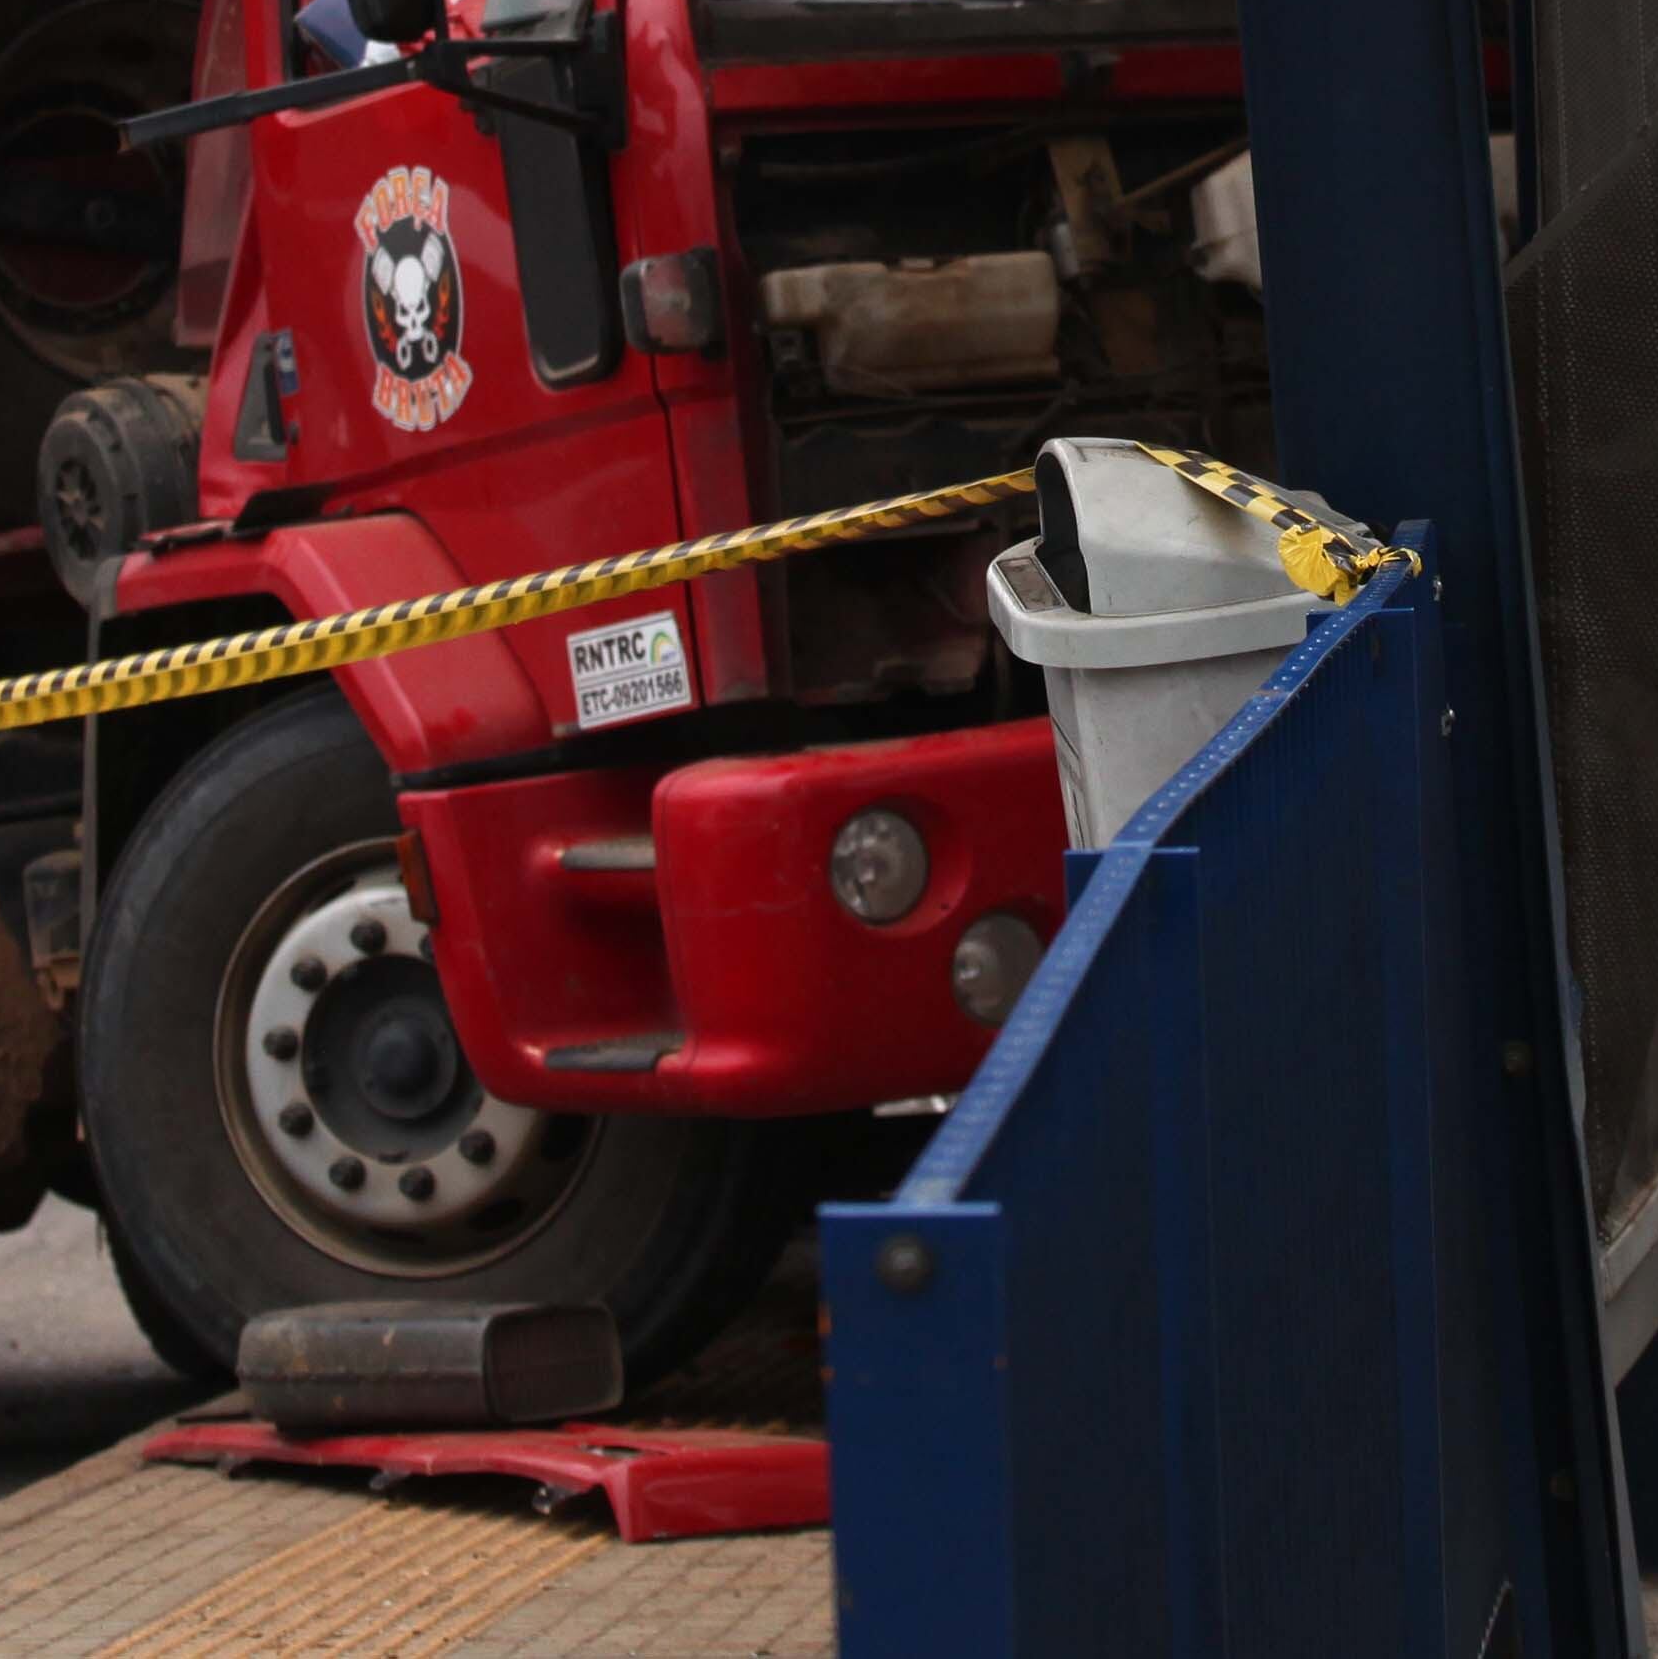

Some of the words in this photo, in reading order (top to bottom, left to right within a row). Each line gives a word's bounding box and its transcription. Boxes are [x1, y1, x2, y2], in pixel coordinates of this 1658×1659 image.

[353, 164, 450, 255] FORÇA
[372, 350, 474, 432] BRUTA
[574, 631, 646, 674] RNTRC
